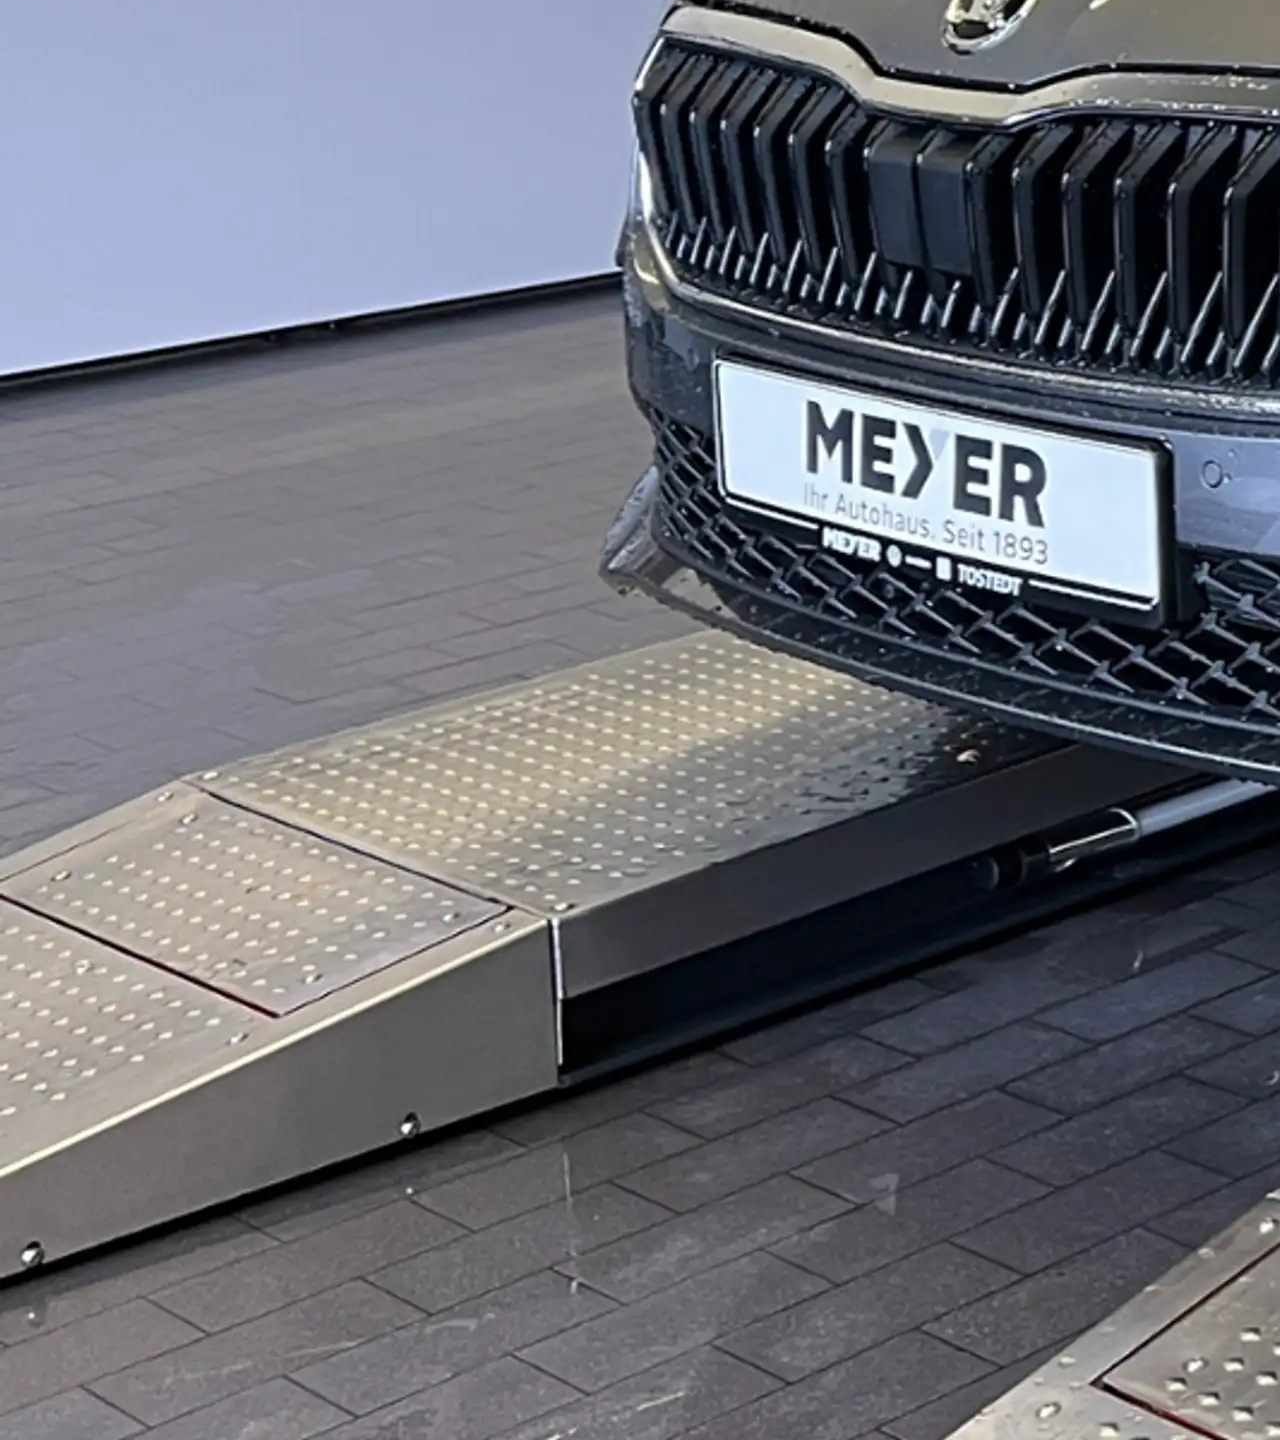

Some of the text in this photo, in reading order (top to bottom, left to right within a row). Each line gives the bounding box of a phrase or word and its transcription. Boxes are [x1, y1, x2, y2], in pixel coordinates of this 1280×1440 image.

[806, 400, 1048, 528] MEYER
[803, 483, 1049, 566] Ihr Autohaus. Seit 1893
[956, 562, 1024, 597] TOSTEDT
